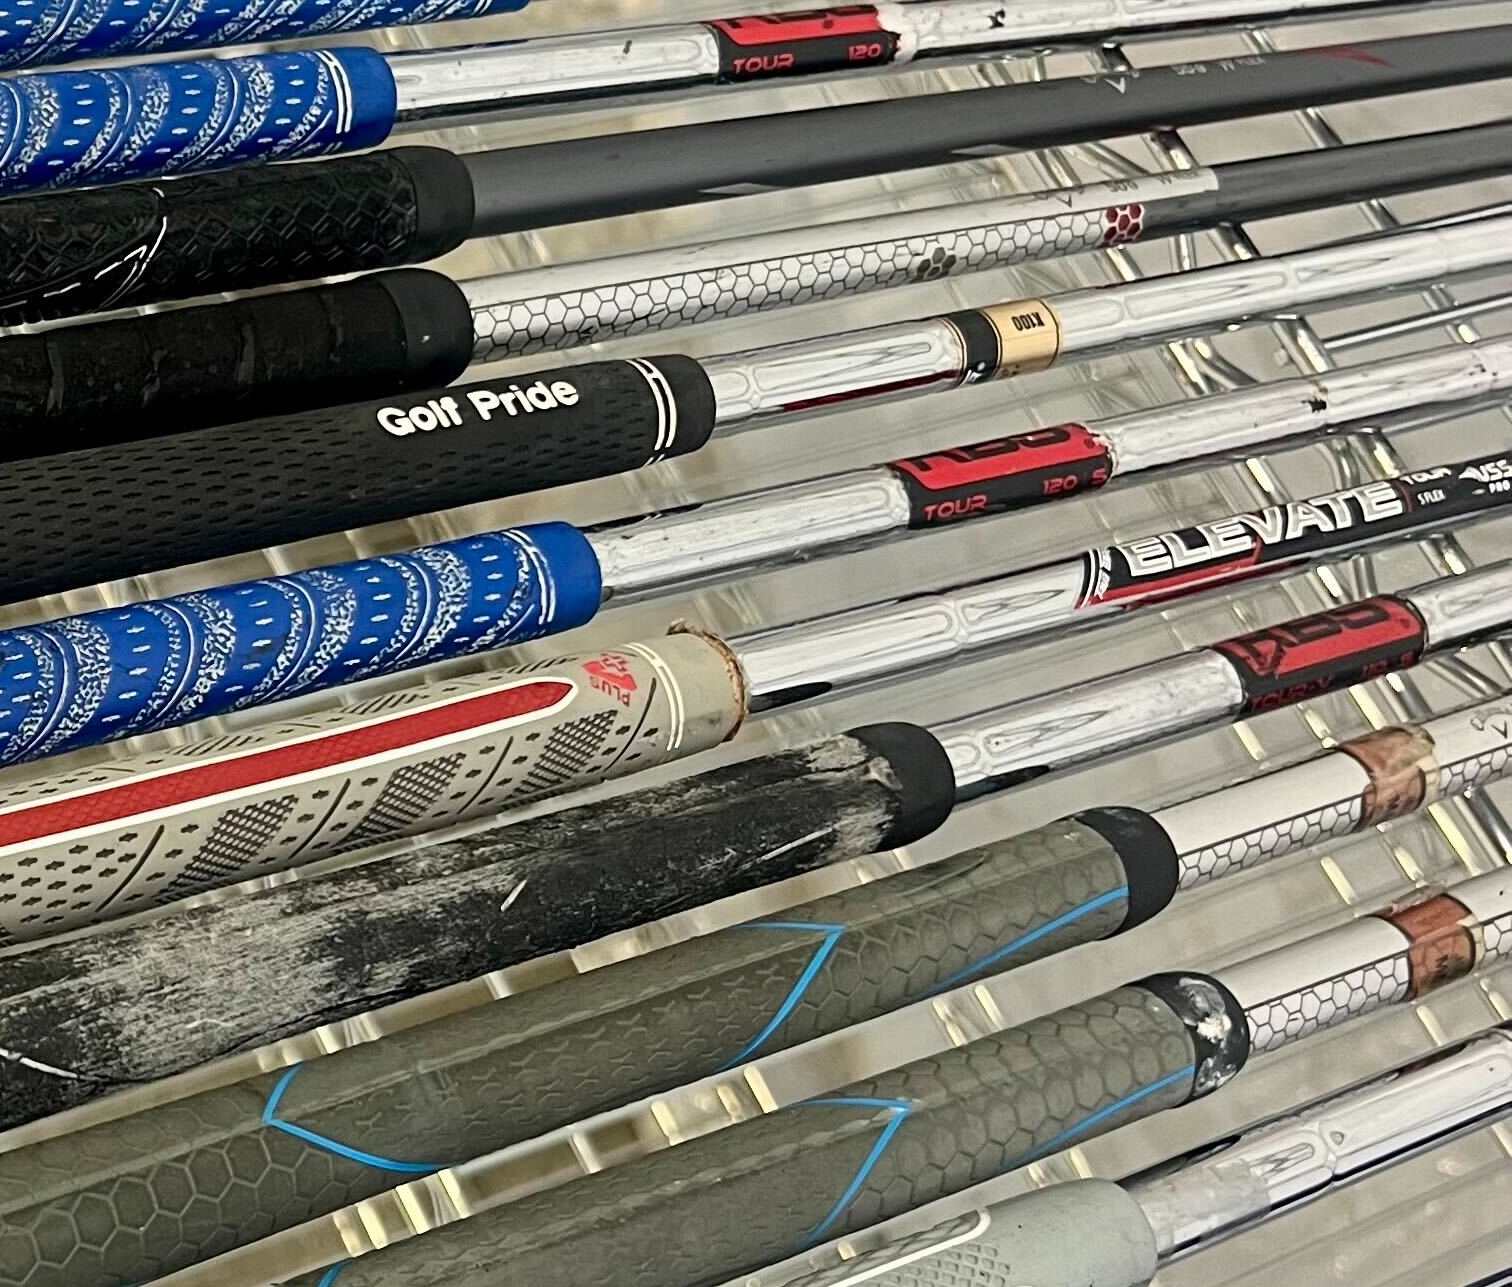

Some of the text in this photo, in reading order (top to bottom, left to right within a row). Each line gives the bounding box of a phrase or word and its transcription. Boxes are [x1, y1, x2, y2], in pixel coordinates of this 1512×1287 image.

[732, 43, 882, 73] TOUR 120
[376, 381, 580, 437] Golf Pride
[923, 494, 988, 521] TOUR
[1042, 475, 1078, 496] 120
[1113, 480, 1404, 577] ELEVATE
[590, 675, 632, 708] PLUS
